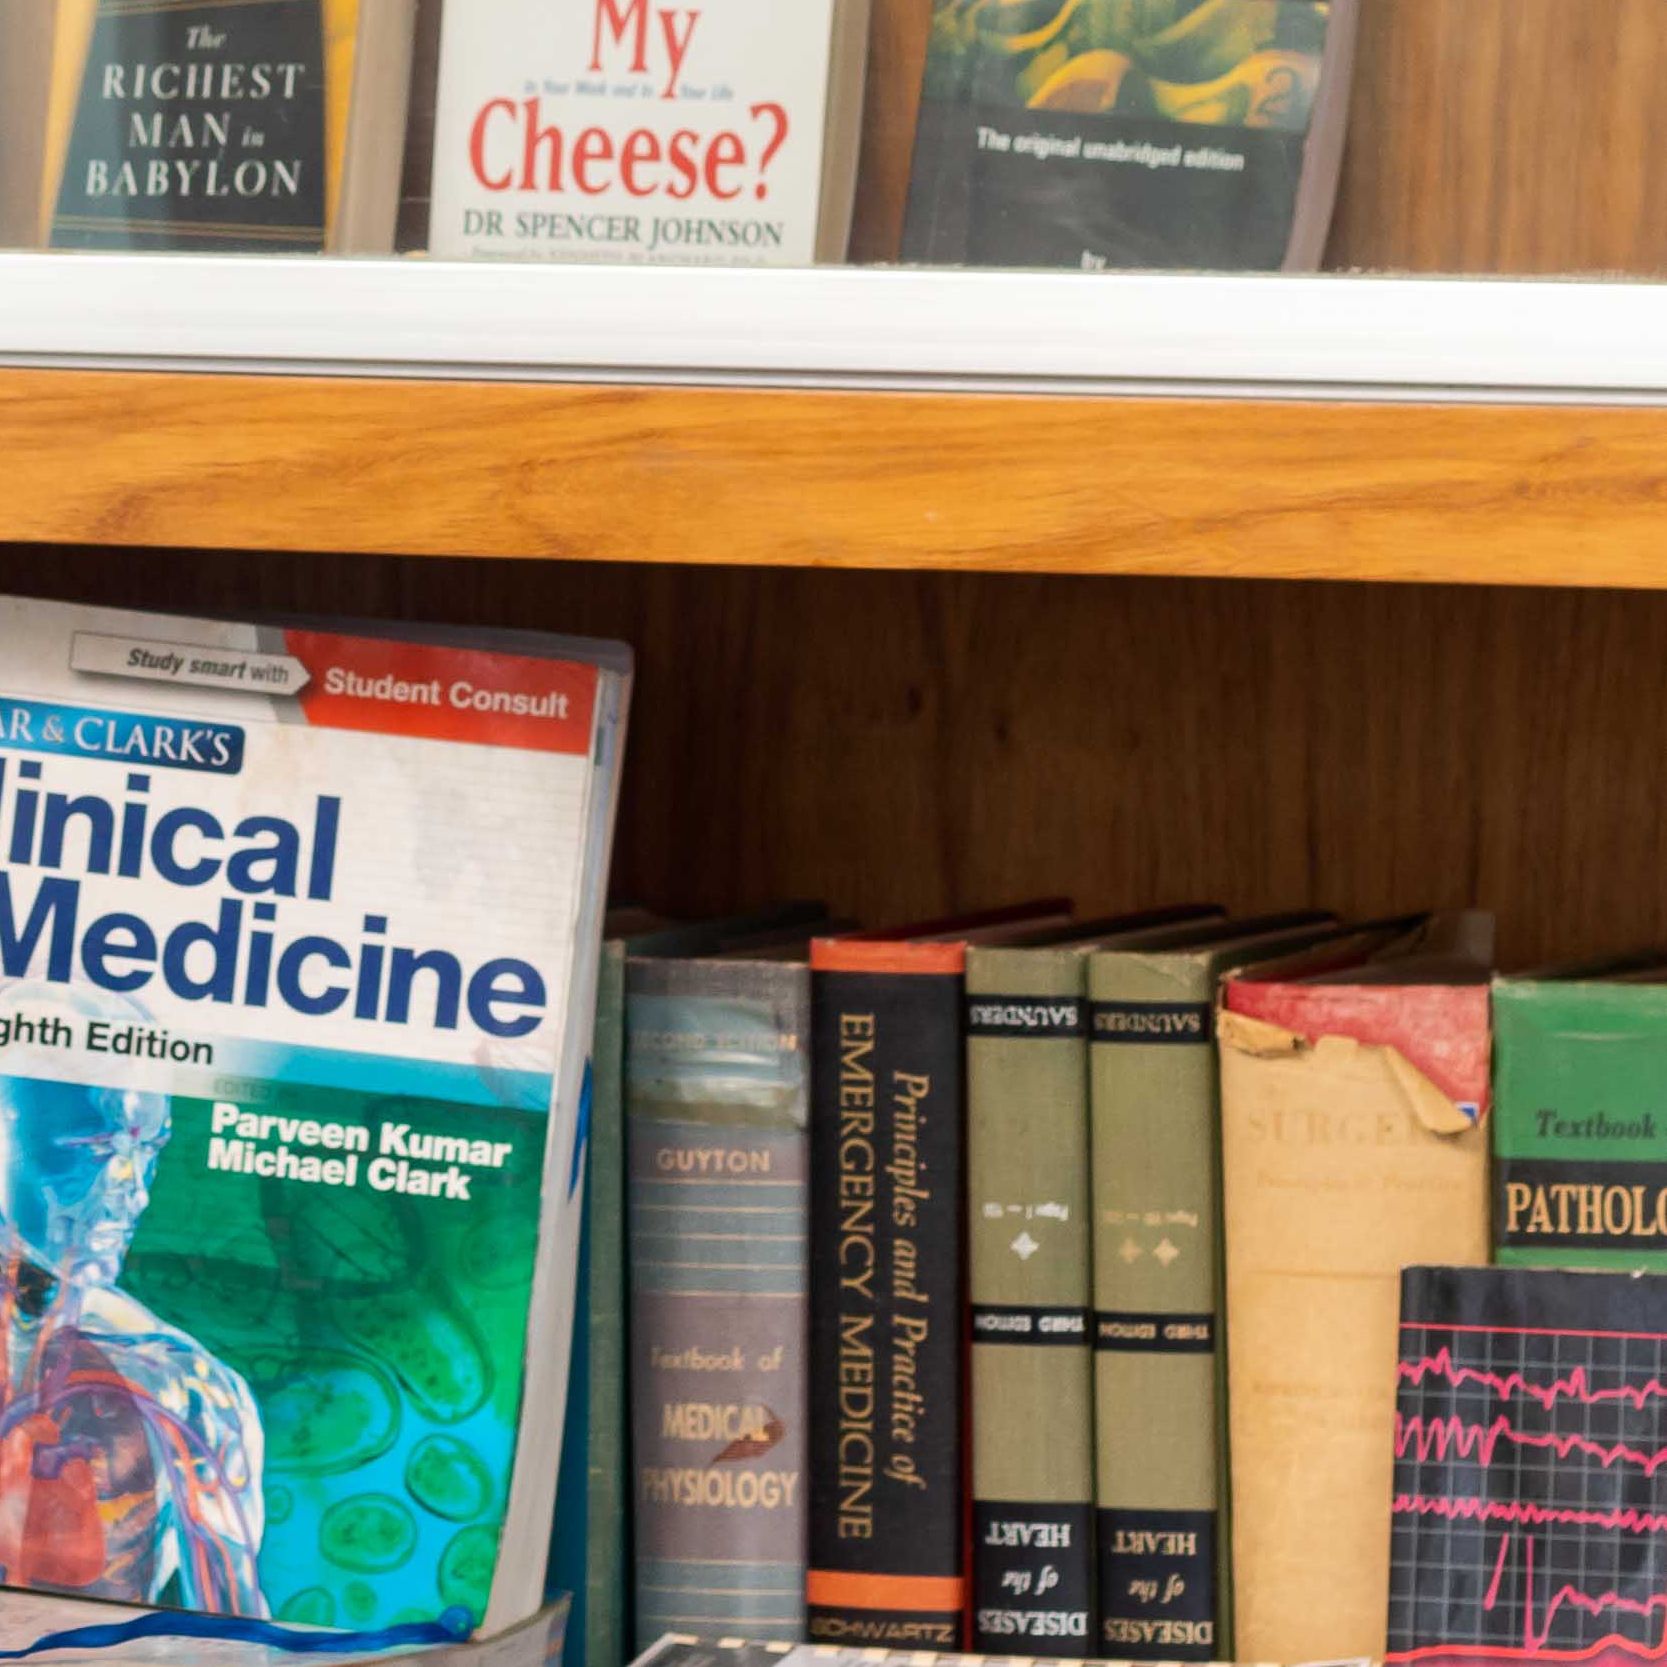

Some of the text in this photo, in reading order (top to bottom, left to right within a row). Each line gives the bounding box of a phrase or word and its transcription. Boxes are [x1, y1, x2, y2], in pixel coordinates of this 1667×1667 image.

[185, 26, 225, 50] The
[102, 63, 305, 99] RICHEST
[129, 112, 265, 147] MAN in
[468, 97, 789, 200] Cheese?
[976, 126, 1245, 172] The original unabridged edition
[85, 159, 302, 196] BABYLON
[463, 208, 784, 251] DR SPENCER JOHNSON
[127, 648, 569, 719] Study smart with Student Consult
[42, 713, 65, 743] &
[73, 716, 232, 767] CLARK'S
[971, 1005, 1078, 1027] SAUNDERS
[1096, 1012, 1201, 1033] SAUNDERS
[86, 1021, 214, 1066] Edition
[211, 1102, 512, 1168] Parveen Kumar
[1536, 1108, 1658, 1141] Textbook
[208, 1137, 472, 1202] Michael Clark
[656, 1147, 771, 1173] GUYTON
[837, 1012, 876, 1539] EMERGENCY MEDICINE
[882, 1070, 931, 1490] Principles and Practice of
[974, 1313, 1085, 1333] THIRD EDITION
[1098, 1322, 1209, 1340] THIRD EDITION
[649, 1346, 784, 1372] Textbook of
[662, 1403, 770, 1442] MEDICAL
[641, 1466, 799, 1509] PHYSIOLOGY
[985, 1521, 1072, 1547] HEART
[1112, 1531, 1198, 1556] HEART
[1001, 1565, 1059, 1597] of the
[1128, 1573, 1186, 1604] of the
[809, 1615, 955, 1644] SCHWARTZ
[978, 1608, 1088, 1636] DISEASES
[1103, 1618, 1214, 1645] DISEASES
